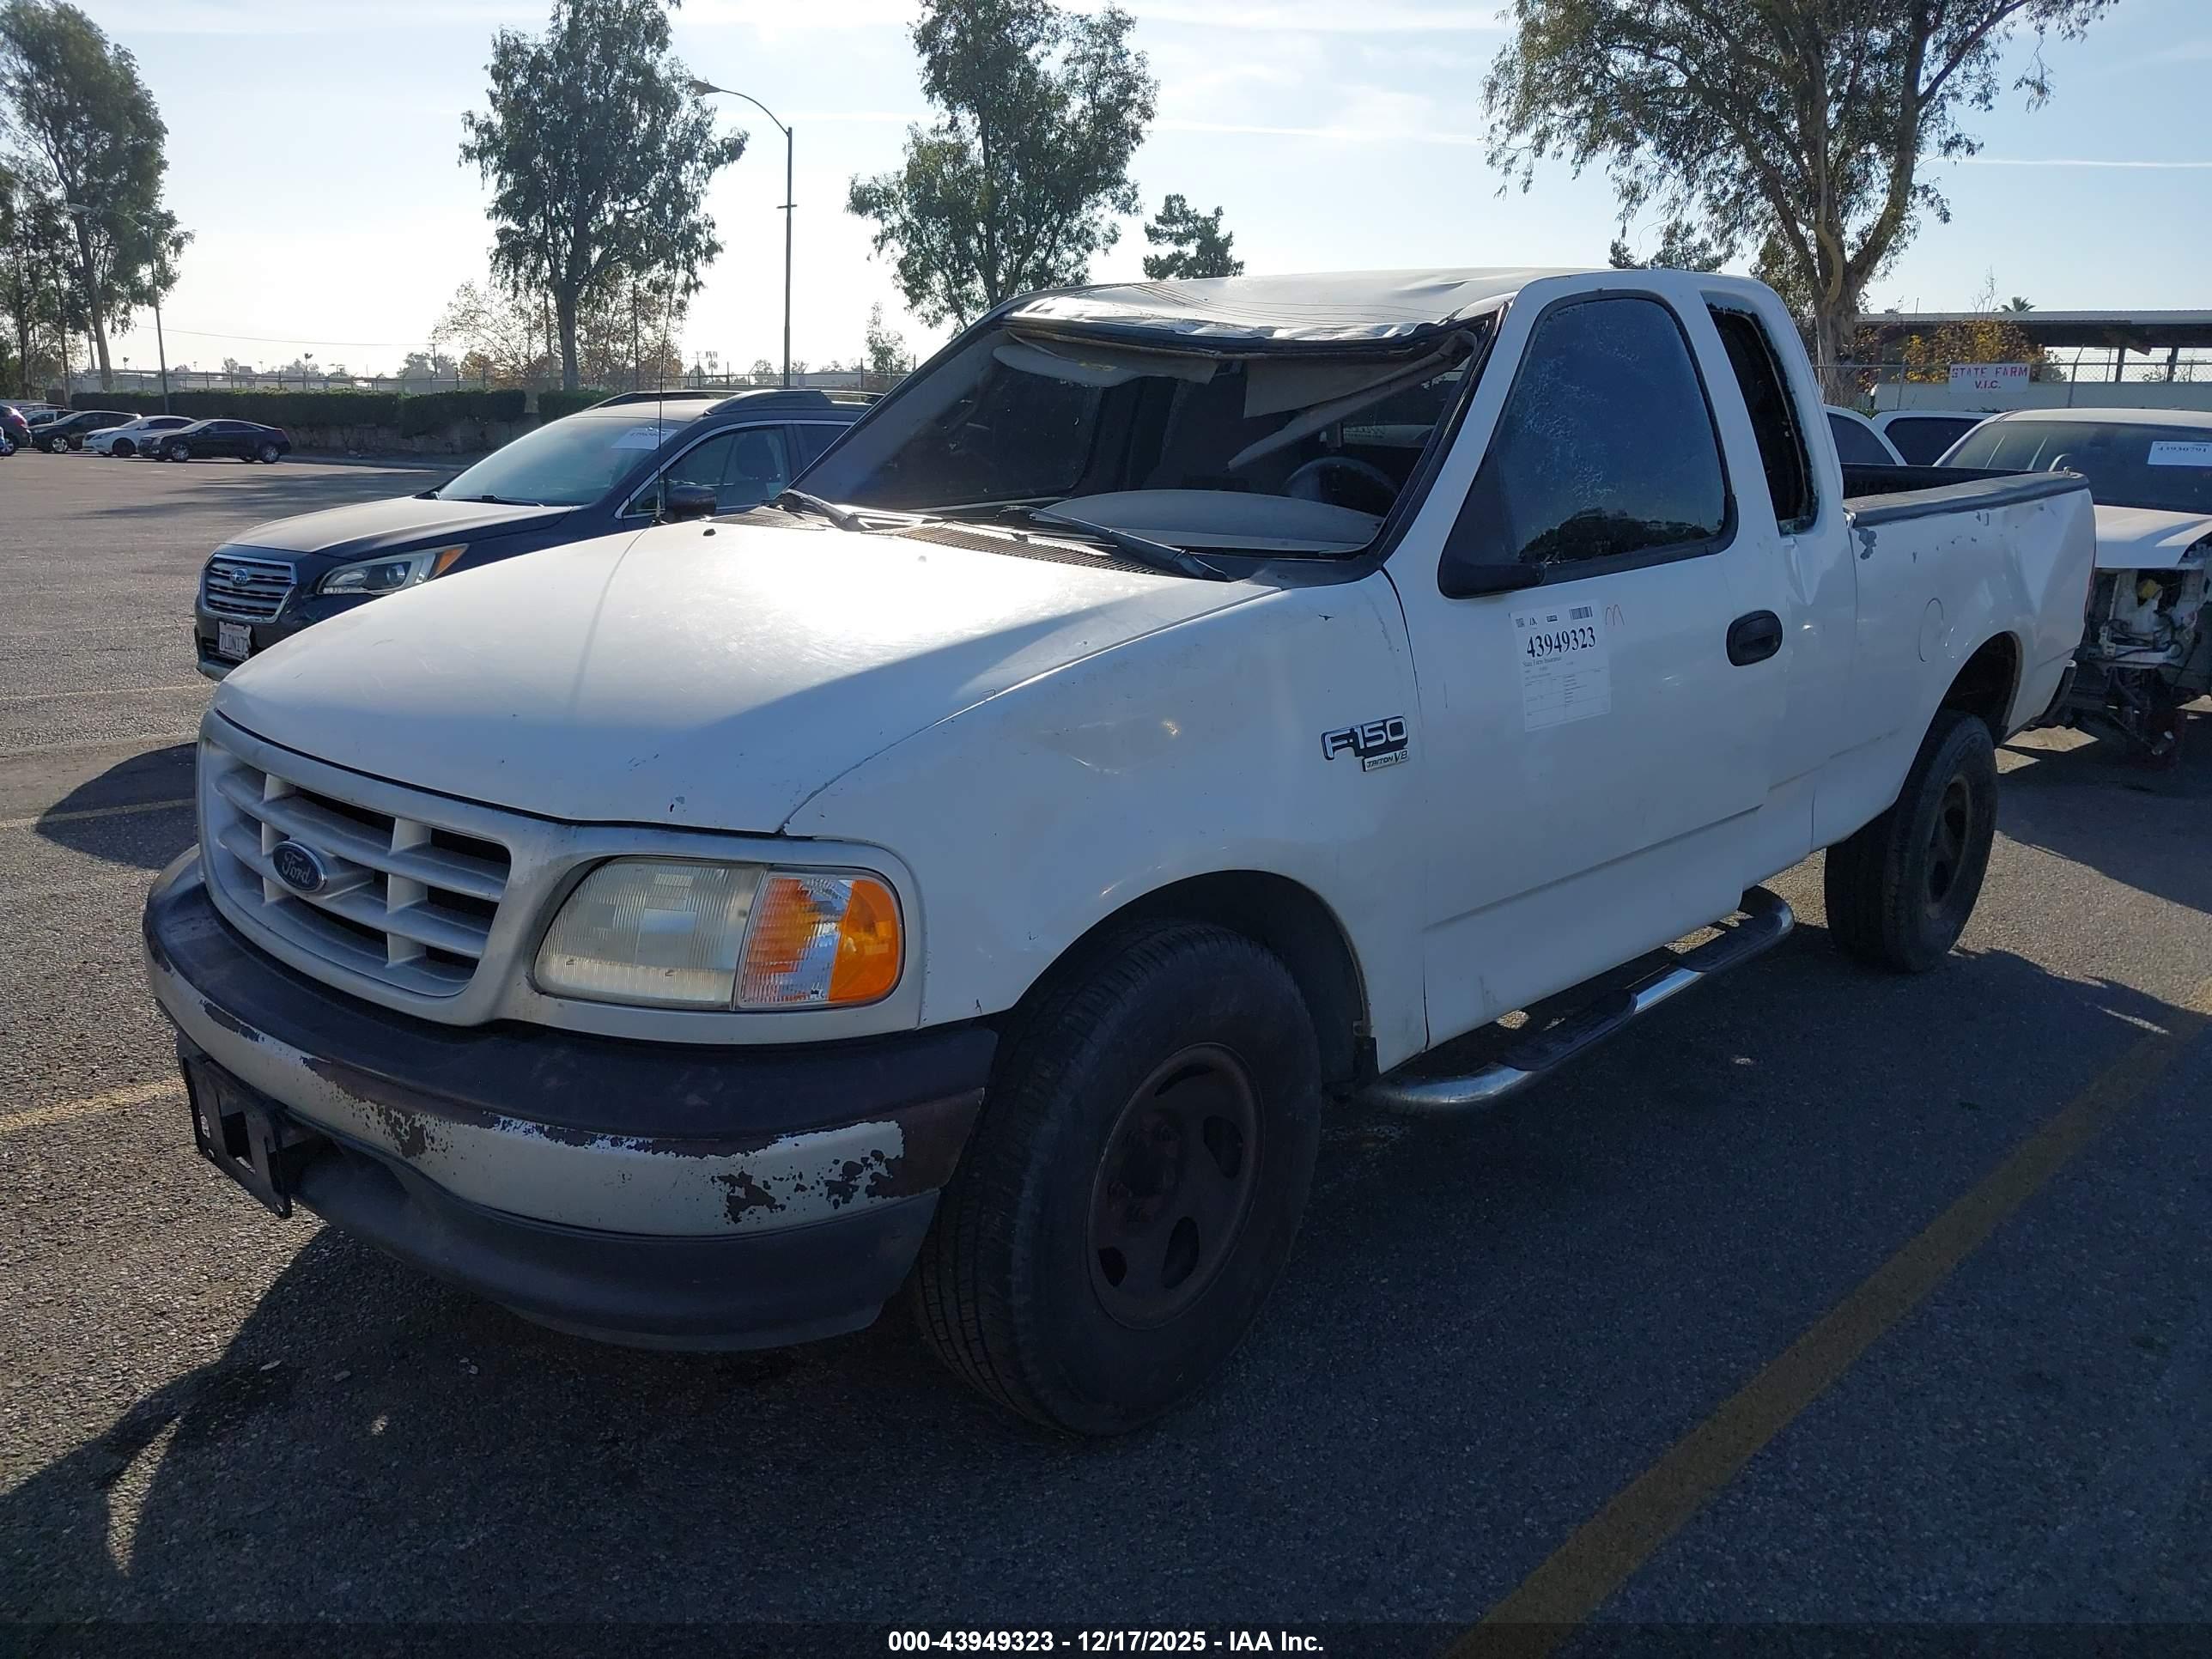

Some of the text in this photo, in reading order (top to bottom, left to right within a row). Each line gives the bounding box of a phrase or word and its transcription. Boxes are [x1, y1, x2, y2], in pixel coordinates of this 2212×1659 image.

[1951, 367, 2027, 379] STATE FARM
[1974, 380, 2002, 390] V.I.C.
[1526, 626, 1595, 658] 43949323
[1366, 750, 1408, 769] TRITON V8
[283, 851, 311, 884] Ford
